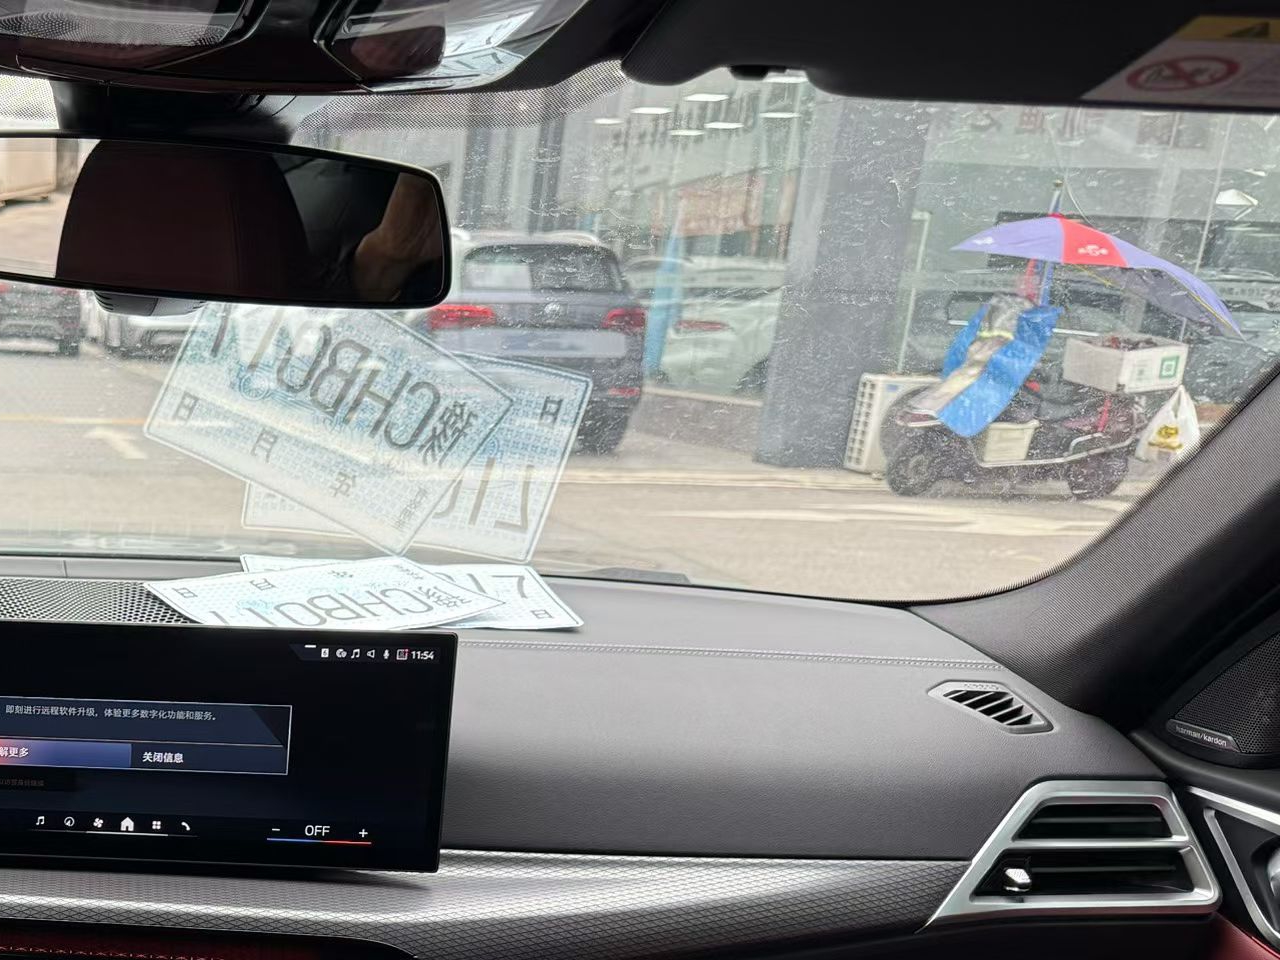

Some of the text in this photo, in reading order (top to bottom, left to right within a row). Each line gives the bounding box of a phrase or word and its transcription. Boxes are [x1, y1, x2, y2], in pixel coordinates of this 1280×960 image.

[411, 650, 435, 660] 11:54
[142, 751, 184, 764] 关闭信息
[304, 824, 330, 837] OFF
